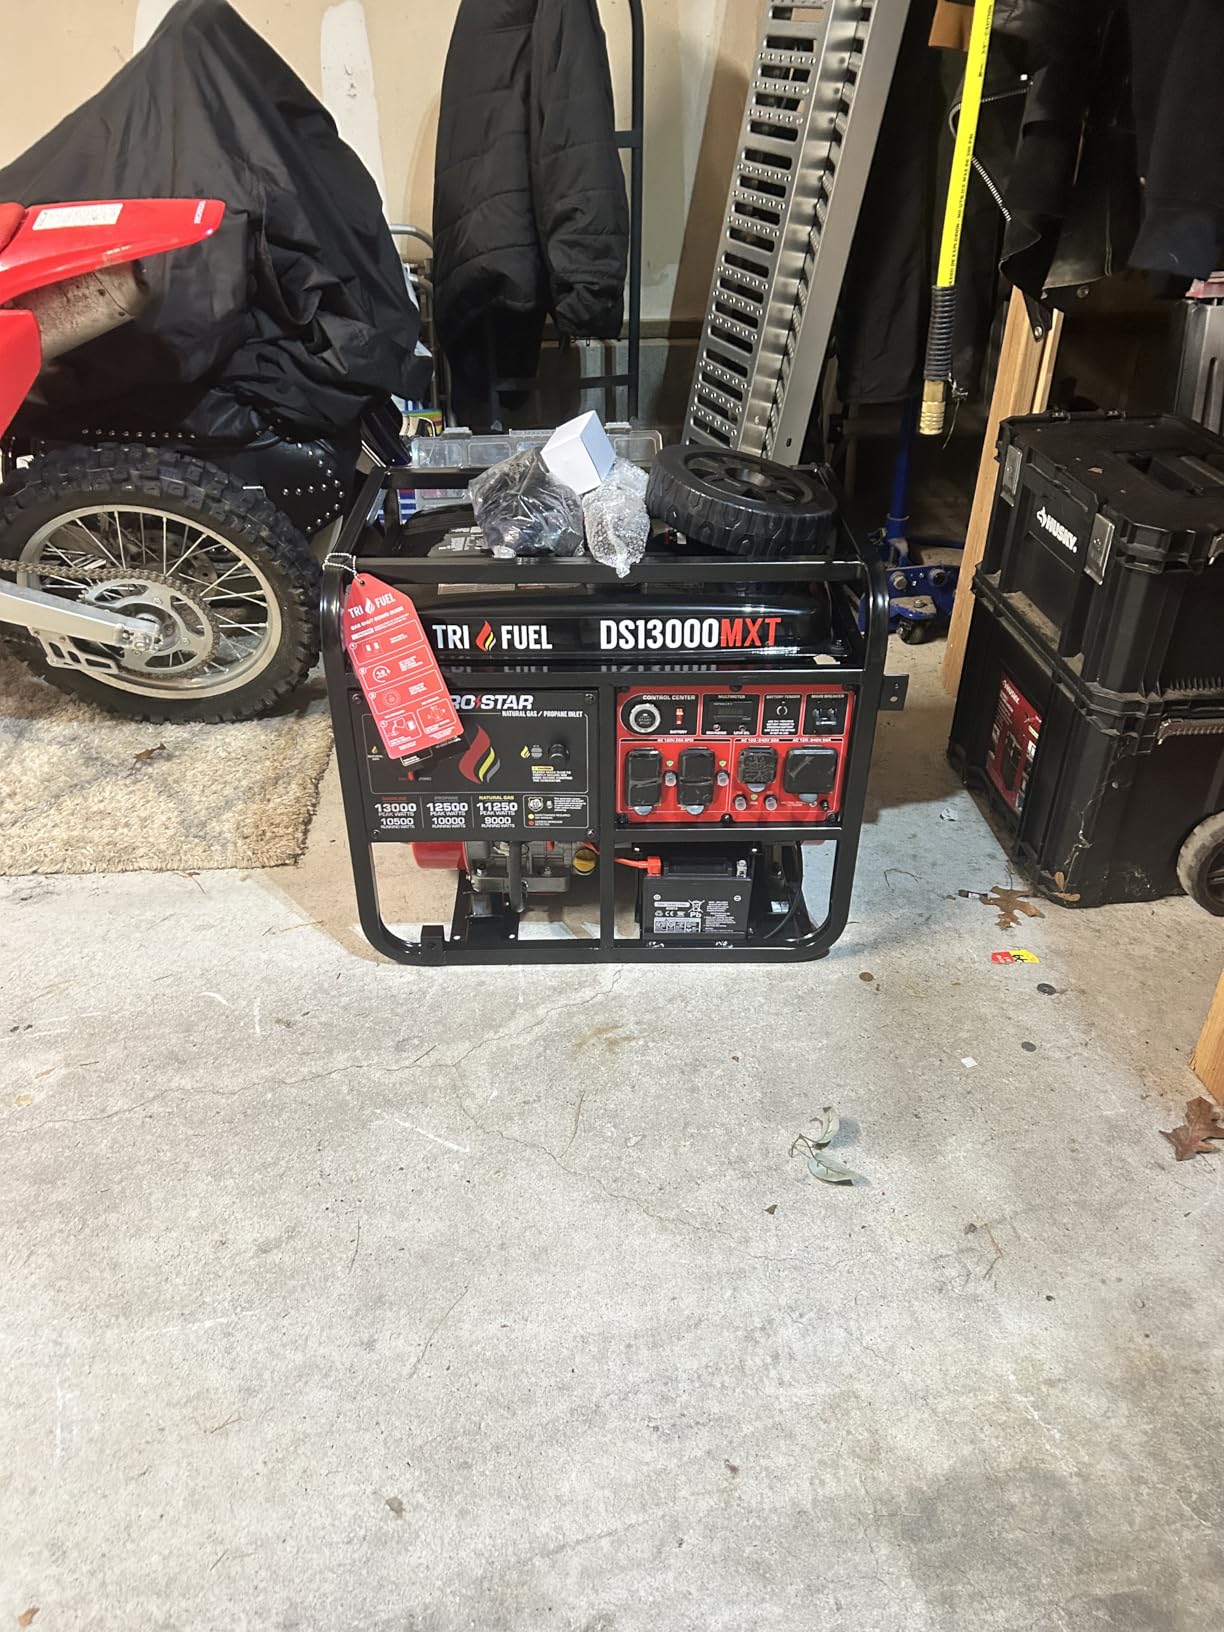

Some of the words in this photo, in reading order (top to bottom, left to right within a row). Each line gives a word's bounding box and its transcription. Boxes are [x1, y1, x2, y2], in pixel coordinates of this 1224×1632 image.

[1045, 514, 1077, 551] HUSKY
[348, 605, 364, 618] TRI
[374, 592, 396, 608] FUEL
[432, 624, 470, 649] TRI
[501, 624, 553, 649] FUEL
[599, 617, 781, 649] DS13000MXT
[451, 694, 476, 710] RO
[480, 694, 534, 710] STAR
[374, 802, 417, 812] 13000
[426, 802, 468, 812] 12500
[476, 802, 518, 811] 11250
[380, 817, 414, 825] 10500
[432, 817, 465, 825] 10000
[484, 816, 511, 824] 9000
